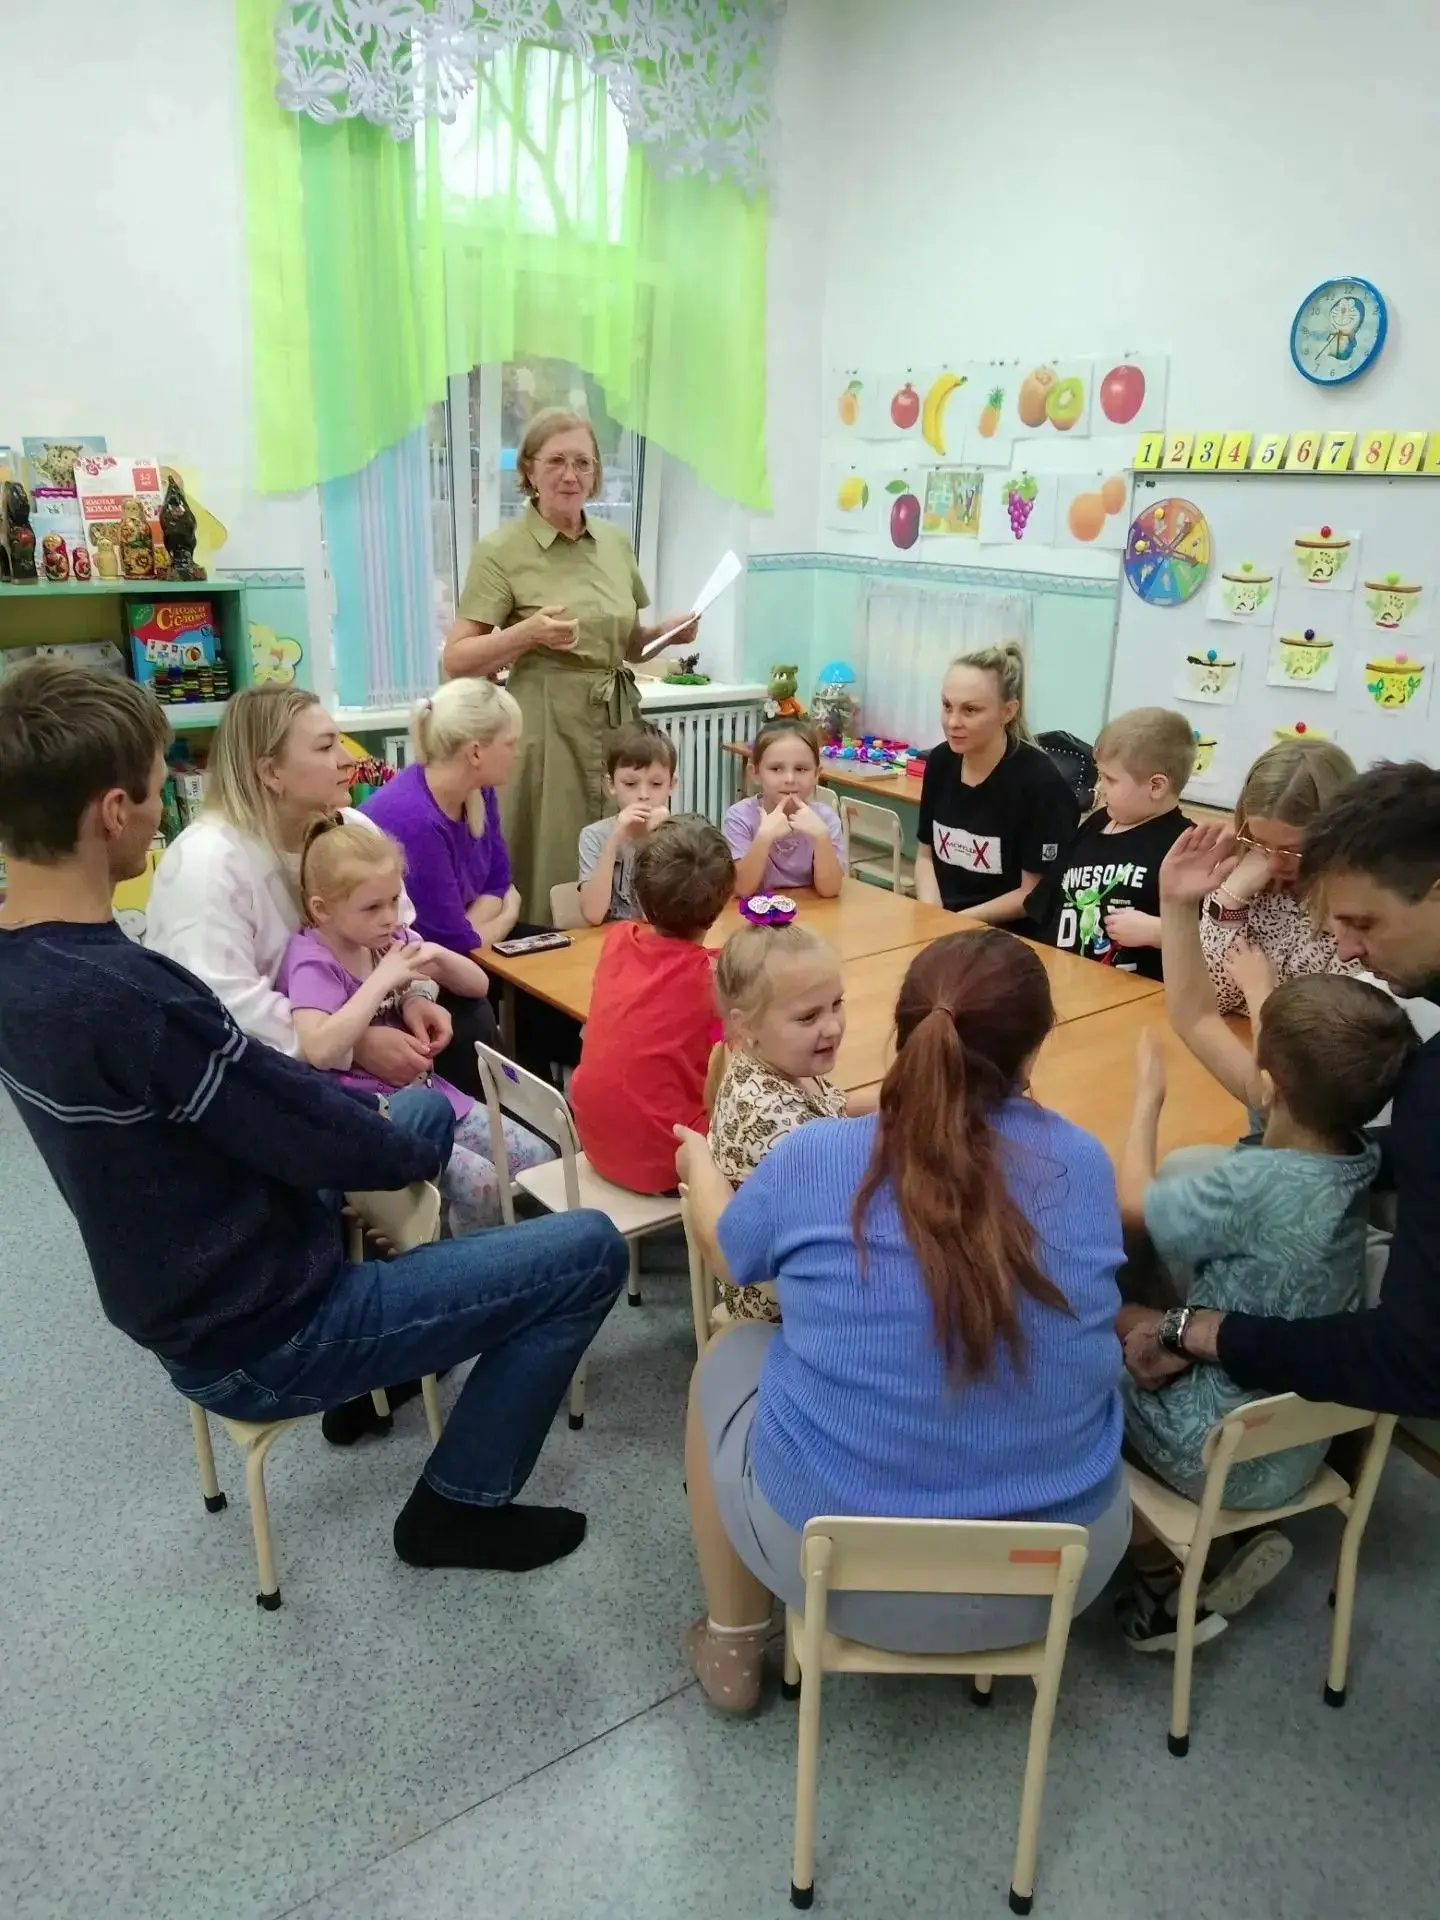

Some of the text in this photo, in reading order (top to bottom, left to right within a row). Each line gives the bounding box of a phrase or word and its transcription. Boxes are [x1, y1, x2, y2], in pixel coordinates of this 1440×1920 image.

[1141, 439, 1415, 465] 1 2 3 4 5 6 7 8 9
[85, 505, 121, 513] ХОХЛОМ
